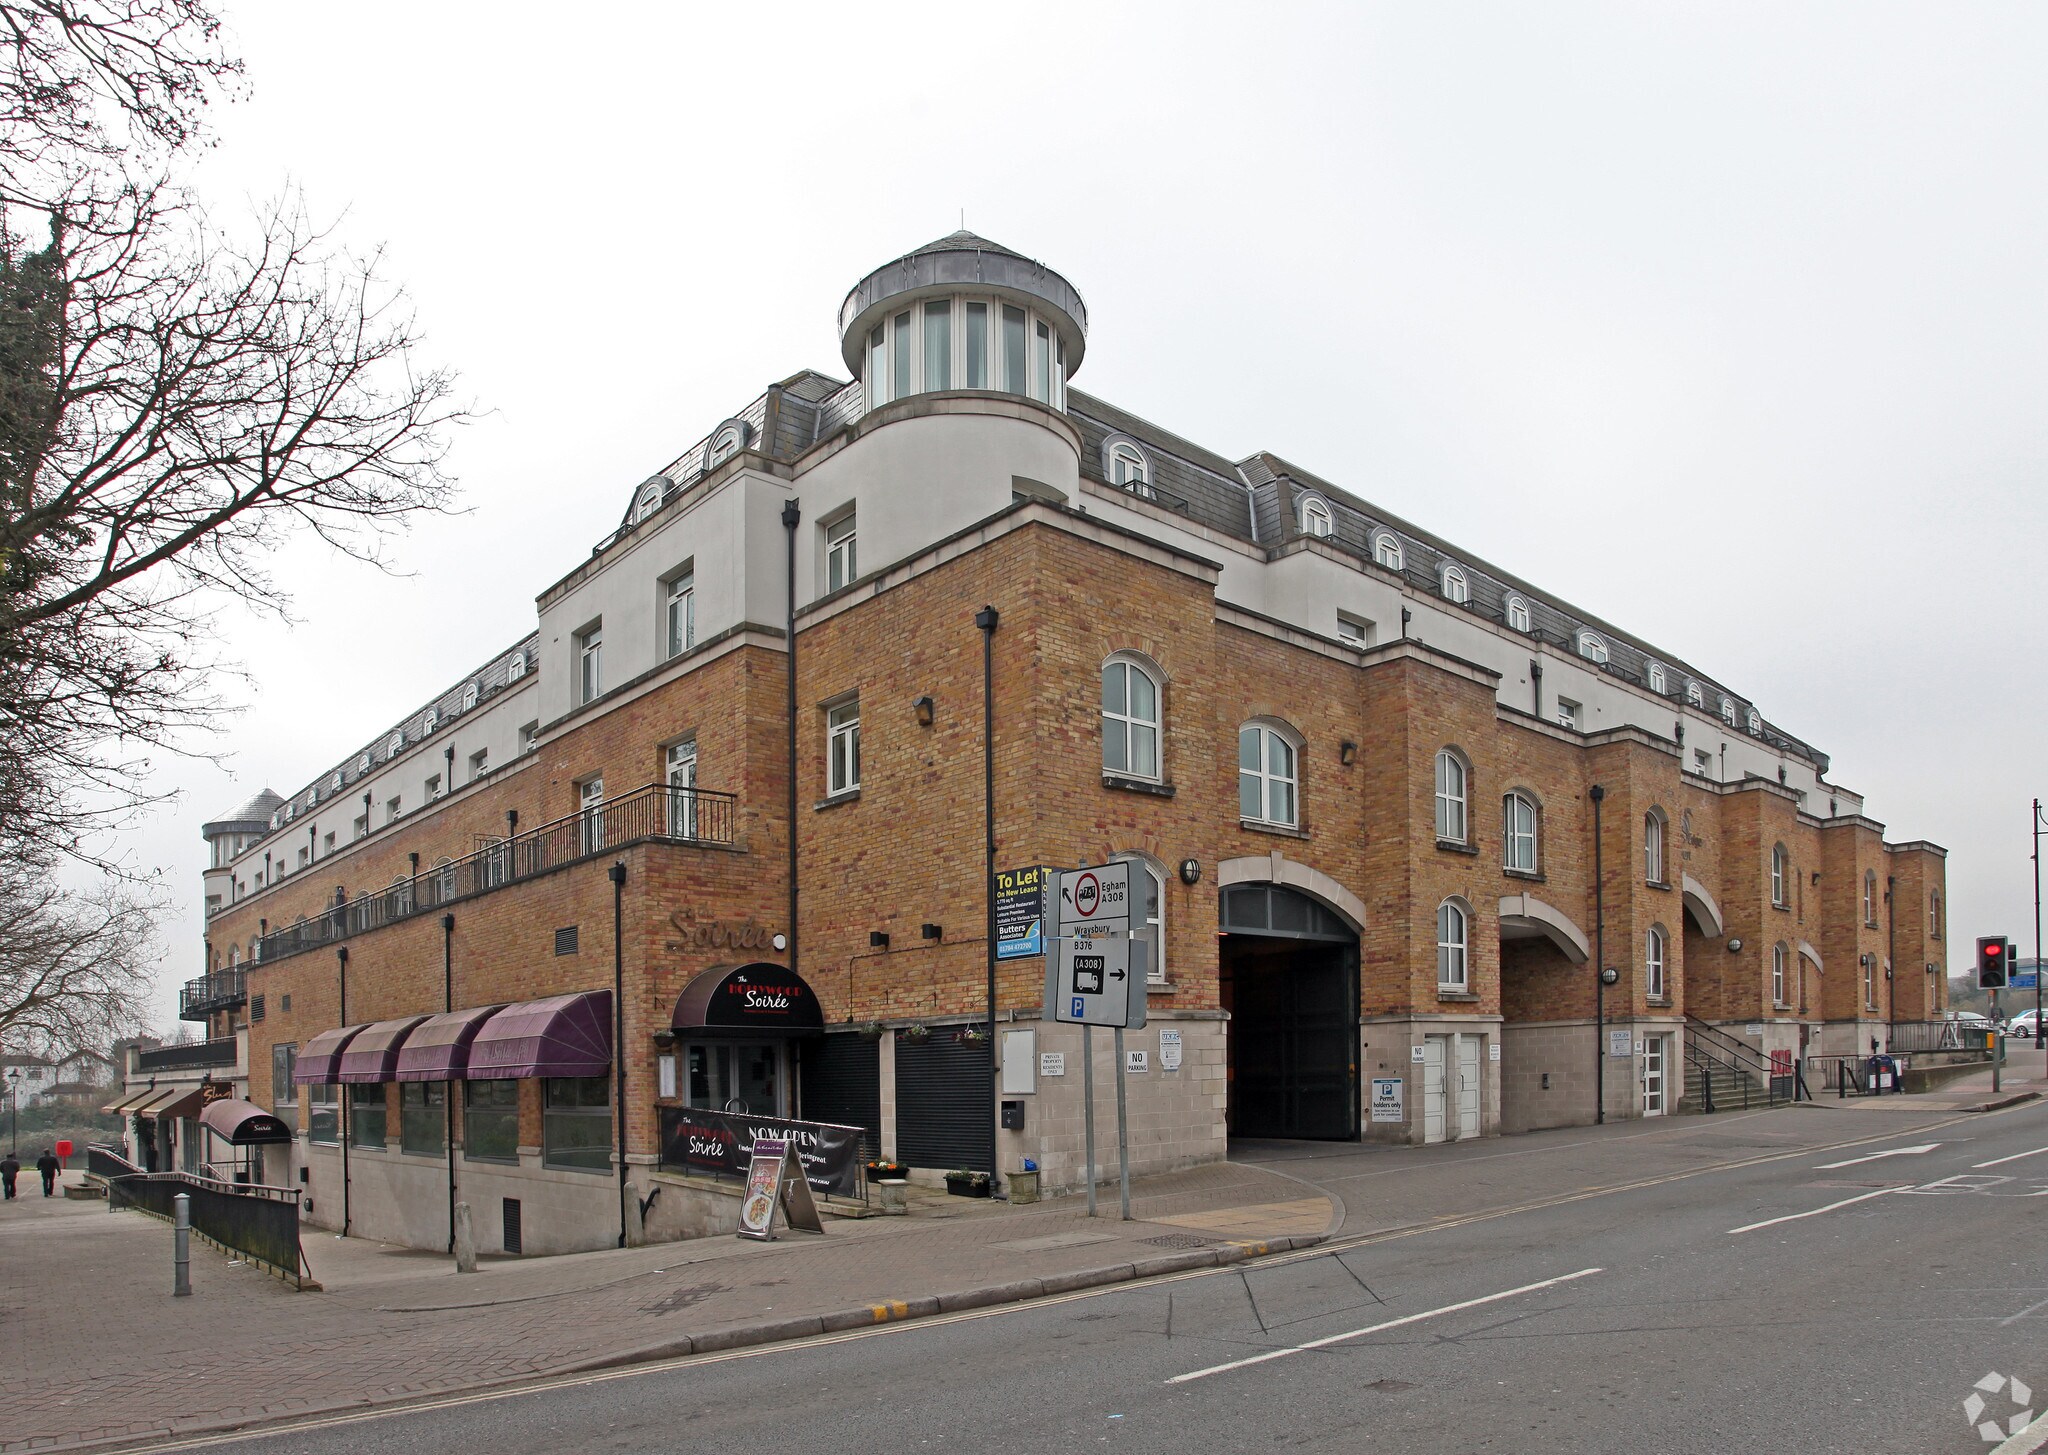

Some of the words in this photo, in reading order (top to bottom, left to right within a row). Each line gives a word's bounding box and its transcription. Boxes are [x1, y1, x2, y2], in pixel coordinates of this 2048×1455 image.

[997, 874, 1012, 889] To
[1017, 868, 1038, 886] Let
[1020, 886, 1038, 894] Lease
[1102, 881, 1126, 892] Egham
[1102, 892, 1124, 903] A308
[1000, 924, 1026, 934] Butters
[1074, 924, 1110, 935] Wraysbury
[1075, 958, 1102, 970] (A308)
[744, 990, 789, 1008] Soirée
[1132, 1053, 1142, 1062] NO
[204, 1086, 231, 1102] Slug
[748, 1126, 780, 1140] NOW
[783, 1129, 817, 1146] OPEN
[689, 1135, 724, 1157] Soirée
